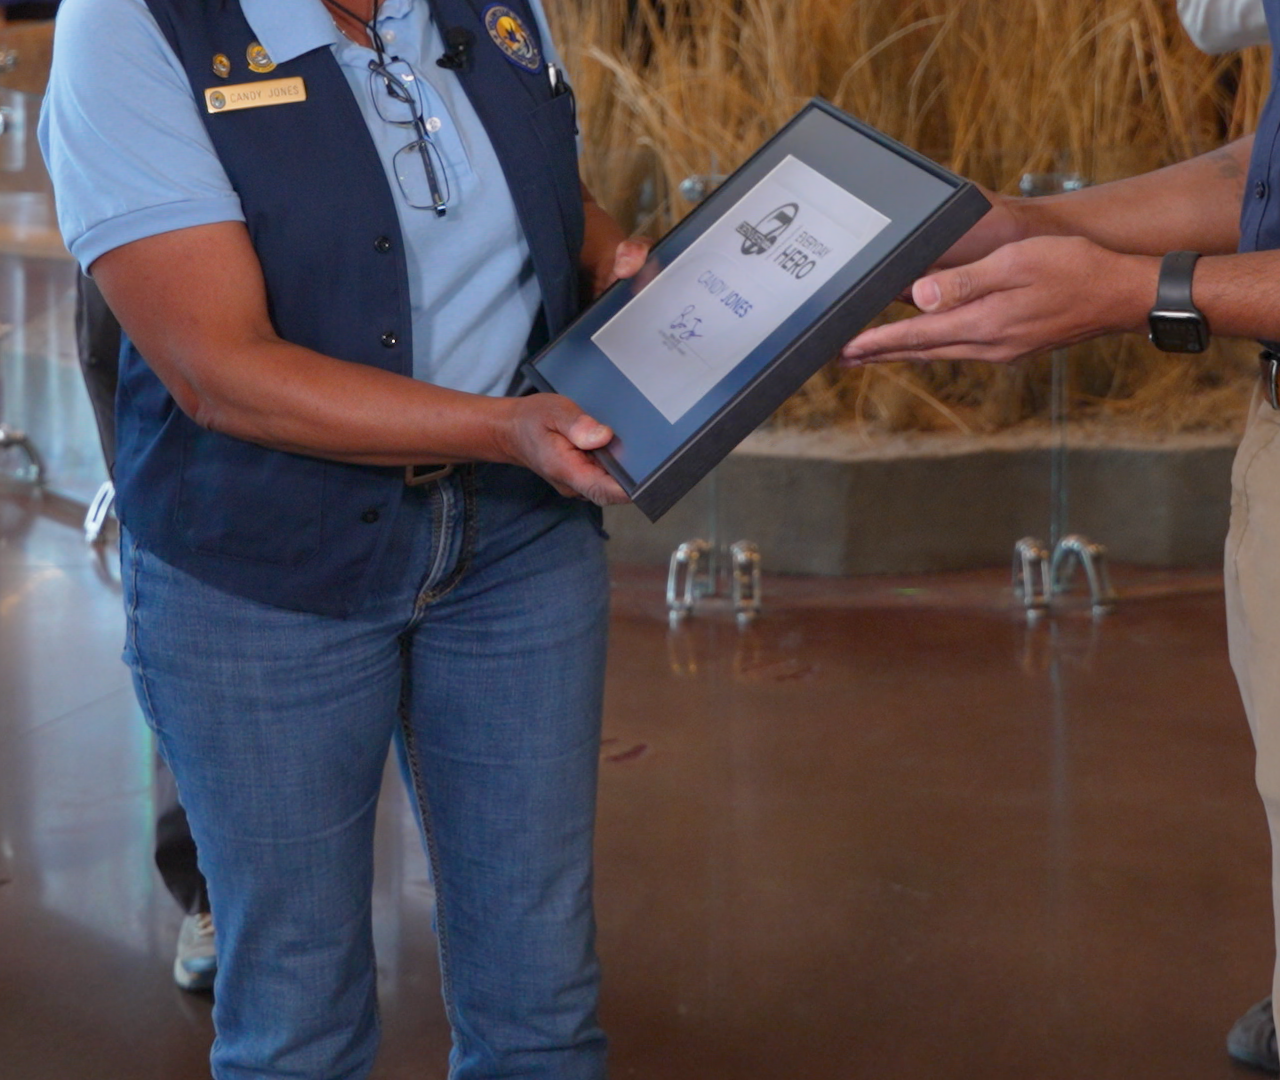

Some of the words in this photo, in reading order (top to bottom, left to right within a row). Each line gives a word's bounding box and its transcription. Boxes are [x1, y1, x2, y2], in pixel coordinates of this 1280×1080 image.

[230, 90, 262, 104] CANDY
[268, 83, 300, 99] JONES
[773, 243, 817, 281] HERO
[720, 288, 753, 319] JONES
